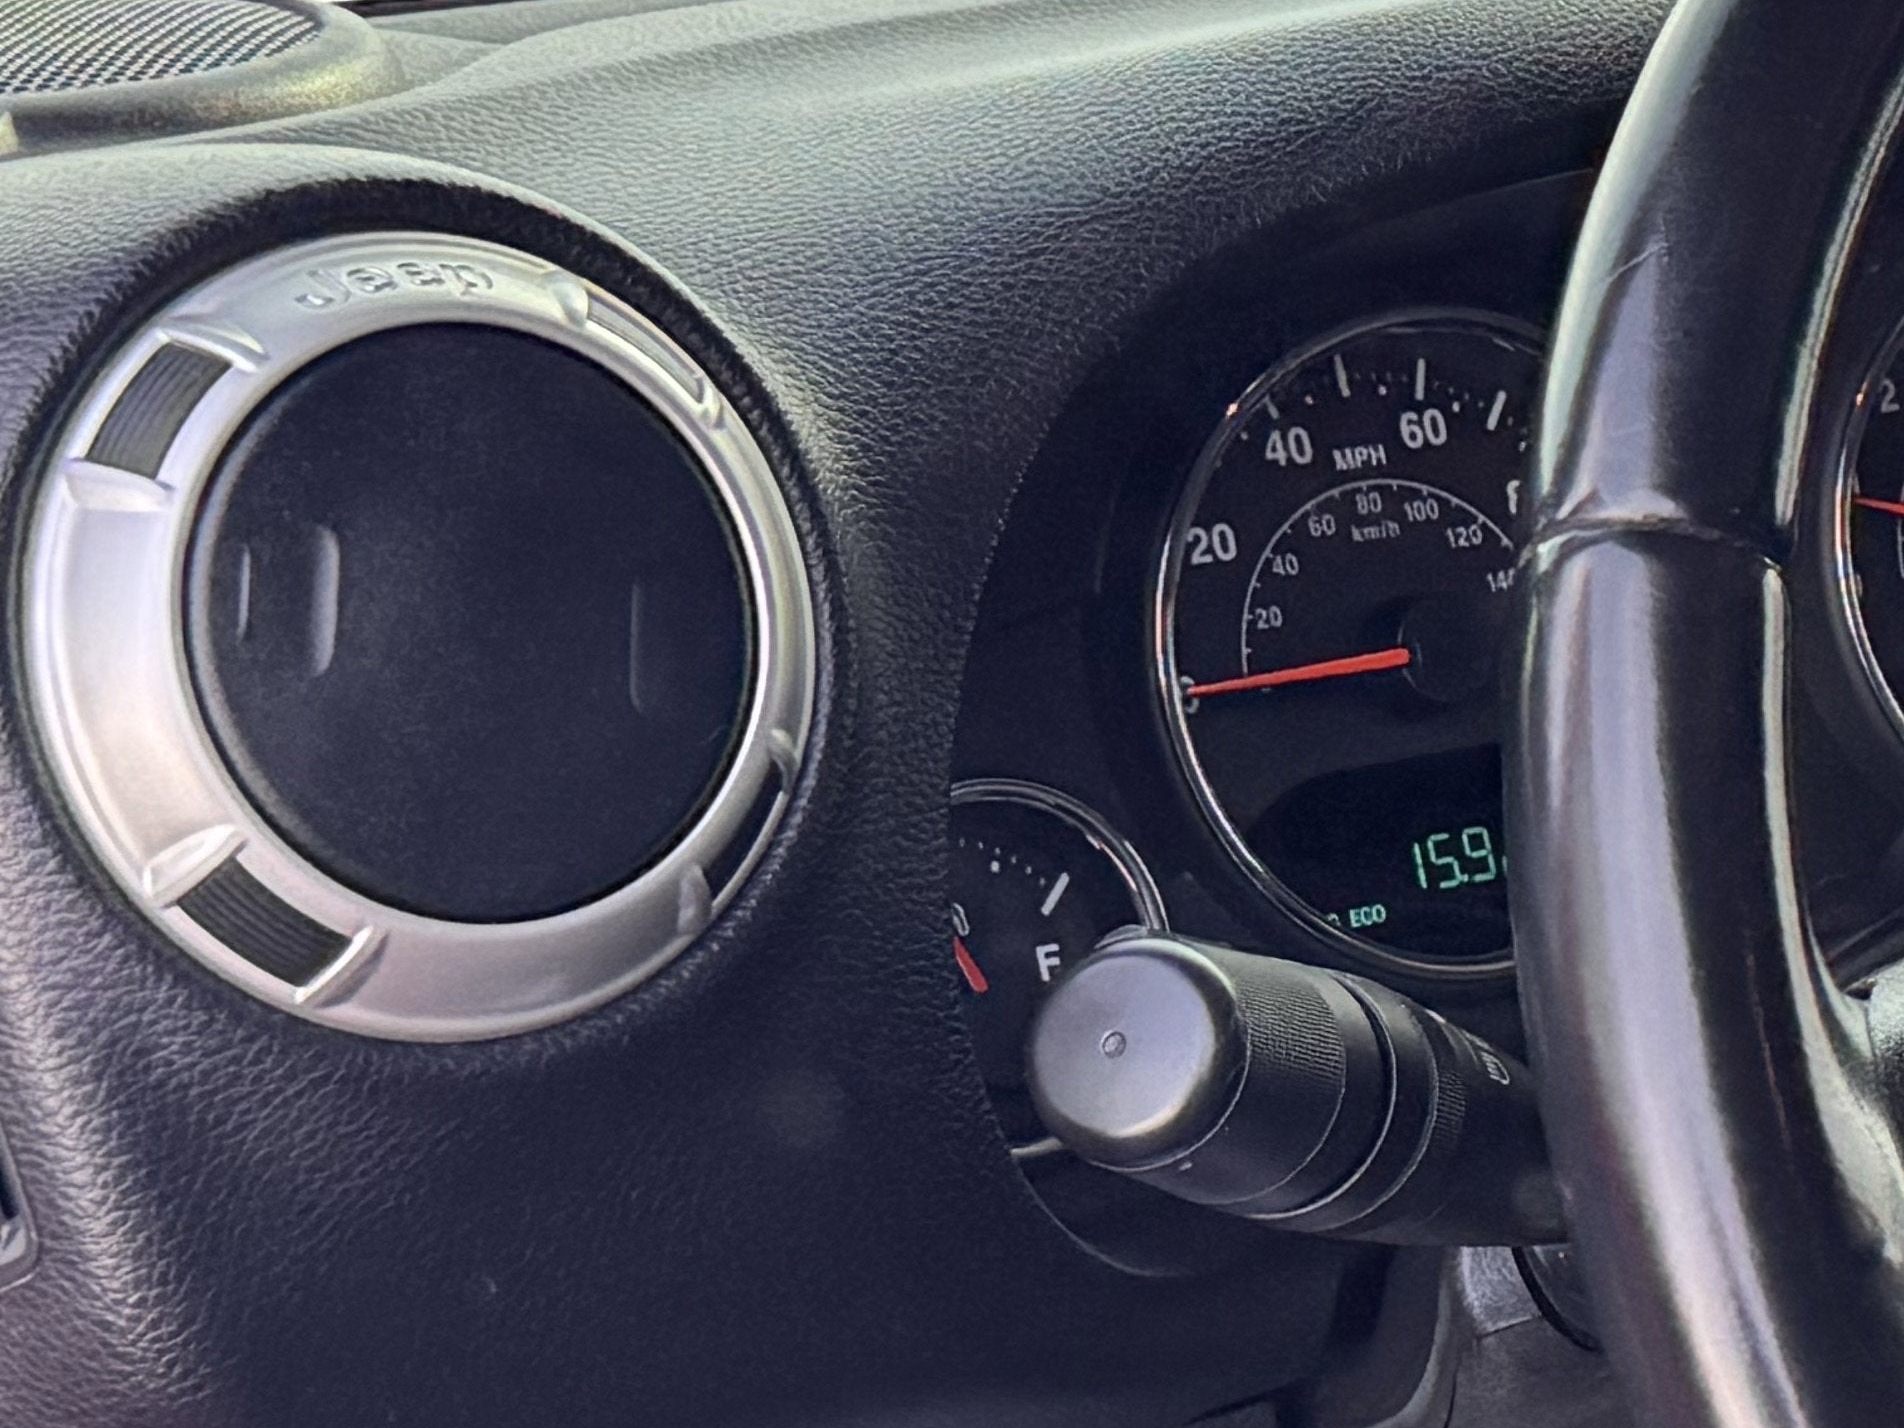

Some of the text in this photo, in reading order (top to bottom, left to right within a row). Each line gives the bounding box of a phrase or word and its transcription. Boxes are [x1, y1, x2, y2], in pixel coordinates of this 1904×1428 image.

[1880, 378, 1900, 413] 2
[1399, 408, 1447, 450] 60
[1264, 426, 1313, 467] 40
[1332, 444, 1388, 472] MPH
[1356, 491, 1383, 514] 80
[1404, 499, 1440, 523] 100
[1308, 513, 1337, 537] 60
[1187, 523, 1238, 565] 20
[1445, 526, 1483, 550] 120
[1272, 552, 1300, 576] 40
[1256, 606, 1283, 630] 20
[1349, 903, 1387, 928] ECO
[1035, 943, 1061, 982] F
